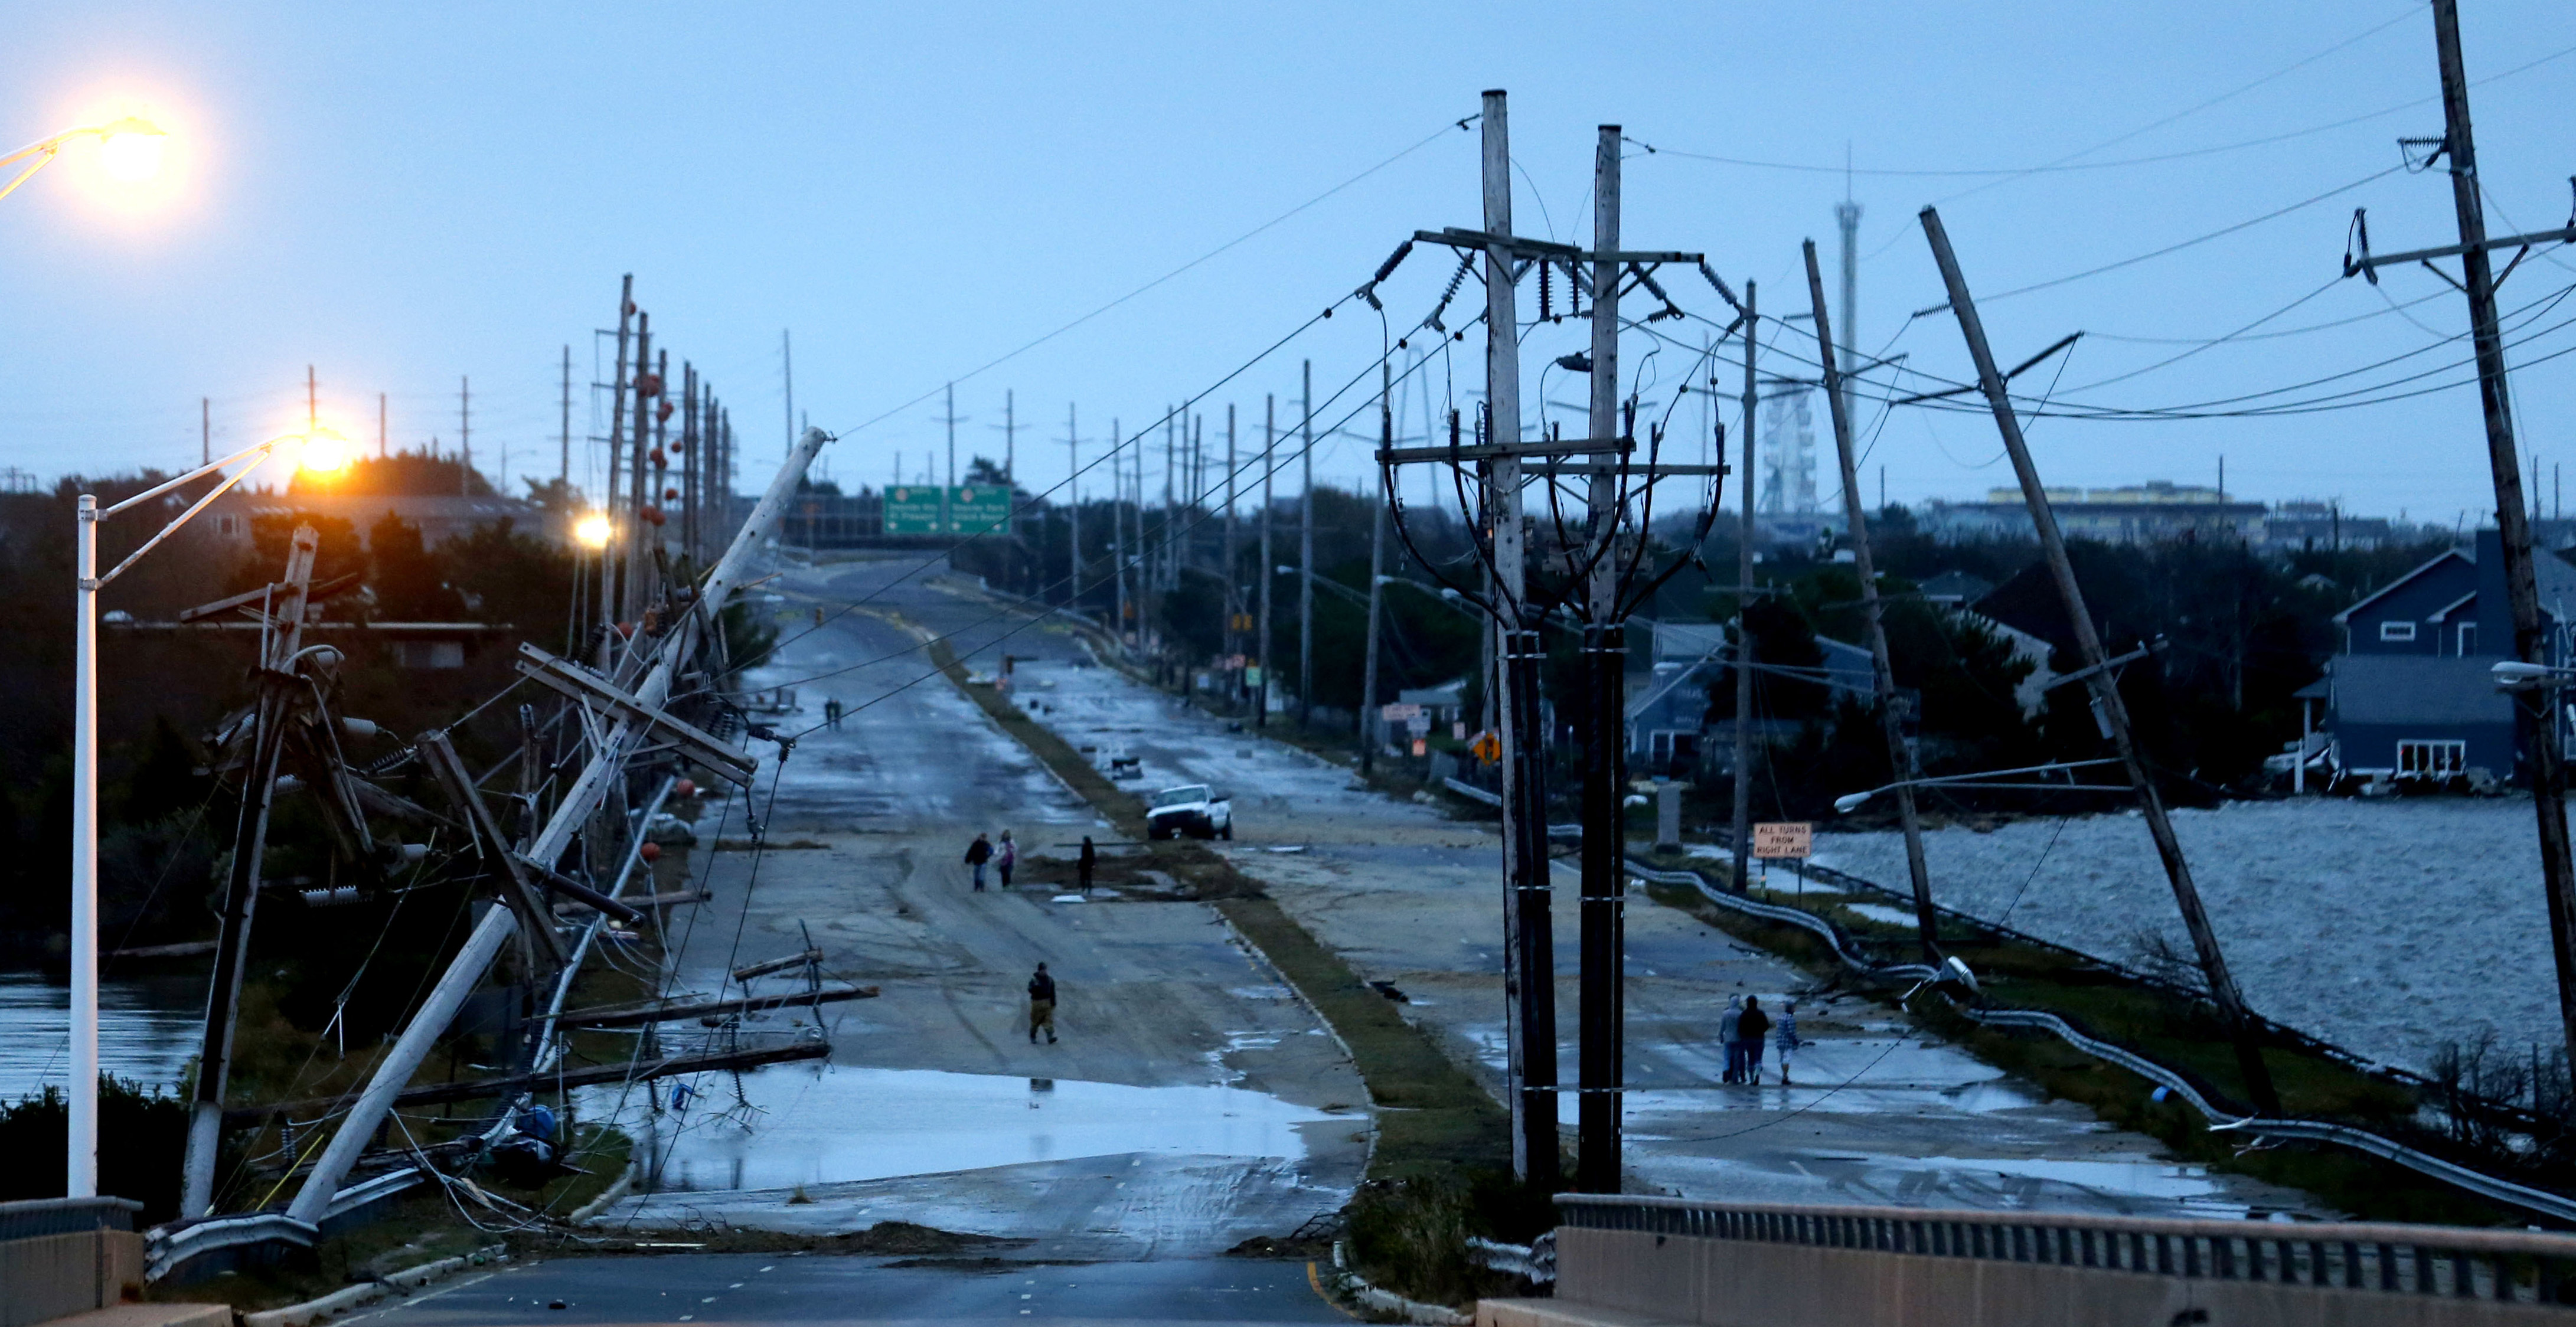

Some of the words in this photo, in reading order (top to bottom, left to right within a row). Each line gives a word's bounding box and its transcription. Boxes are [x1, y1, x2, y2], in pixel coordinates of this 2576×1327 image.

[1779, 826, 1807, 834] TURNS
[1757, 845, 1781, 854] RIGHT
[1785, 845, 1807, 854] LANE
